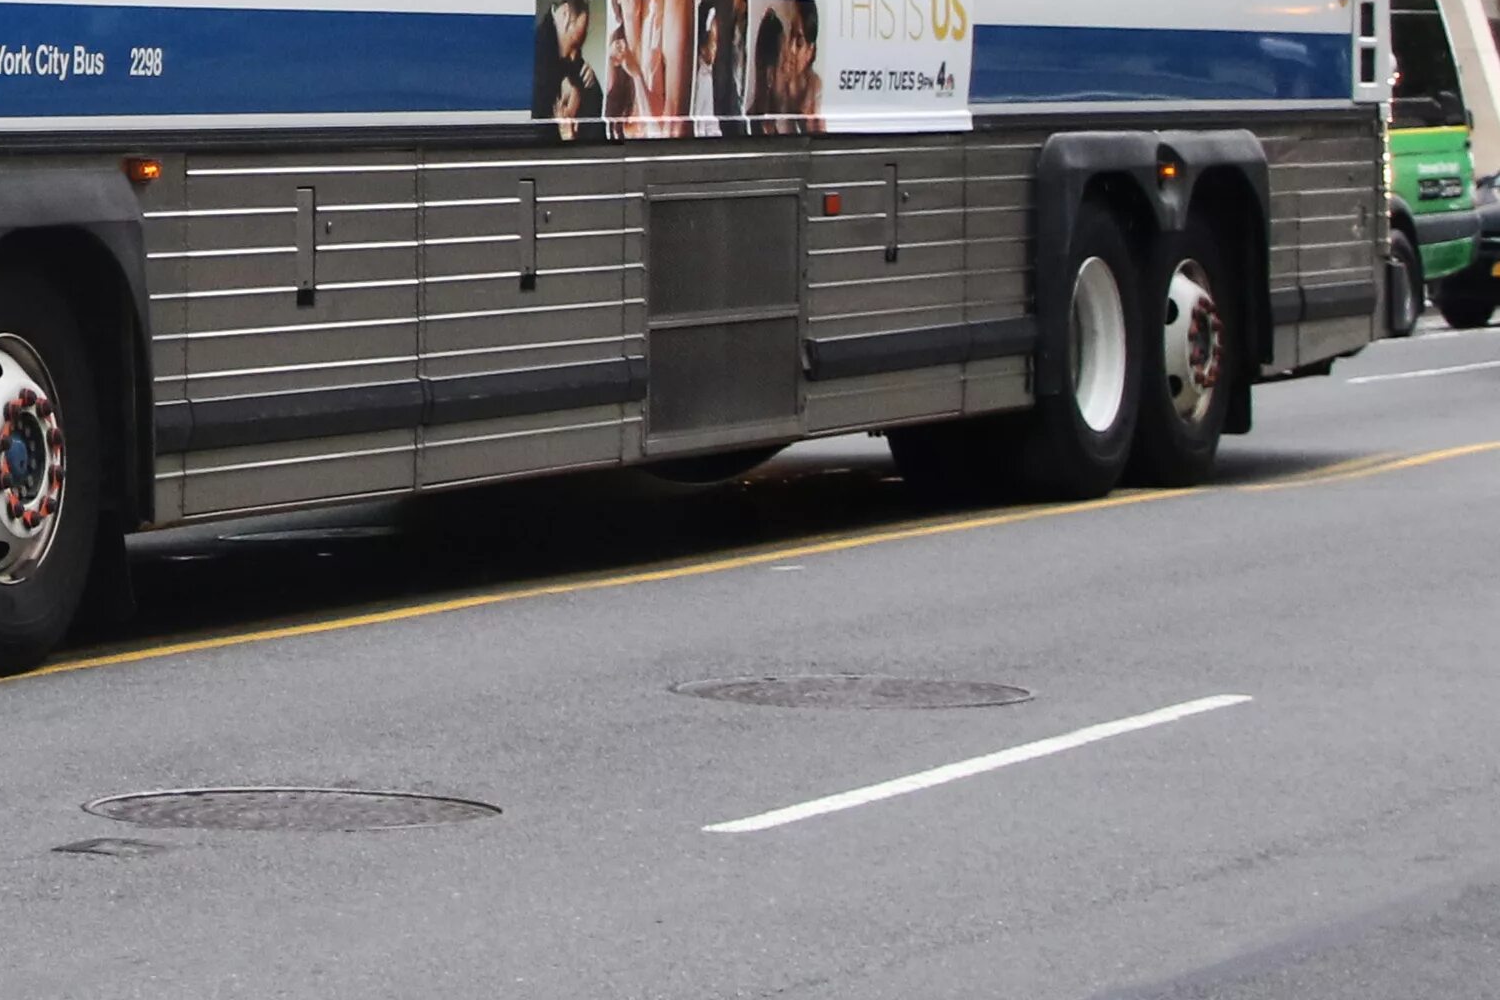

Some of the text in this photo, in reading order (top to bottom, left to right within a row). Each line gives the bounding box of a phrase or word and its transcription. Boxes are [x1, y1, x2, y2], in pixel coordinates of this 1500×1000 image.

[35, 44, 69, 81] City
[73, 45, 104, 76] Bus
[129, 47, 163, 77] 2298
[839, 69, 867, 91] SEPT
[868, 70, 883, 91] 26
[888, 71, 915, 91] TUES
[936, 60, 947, 91] 4
